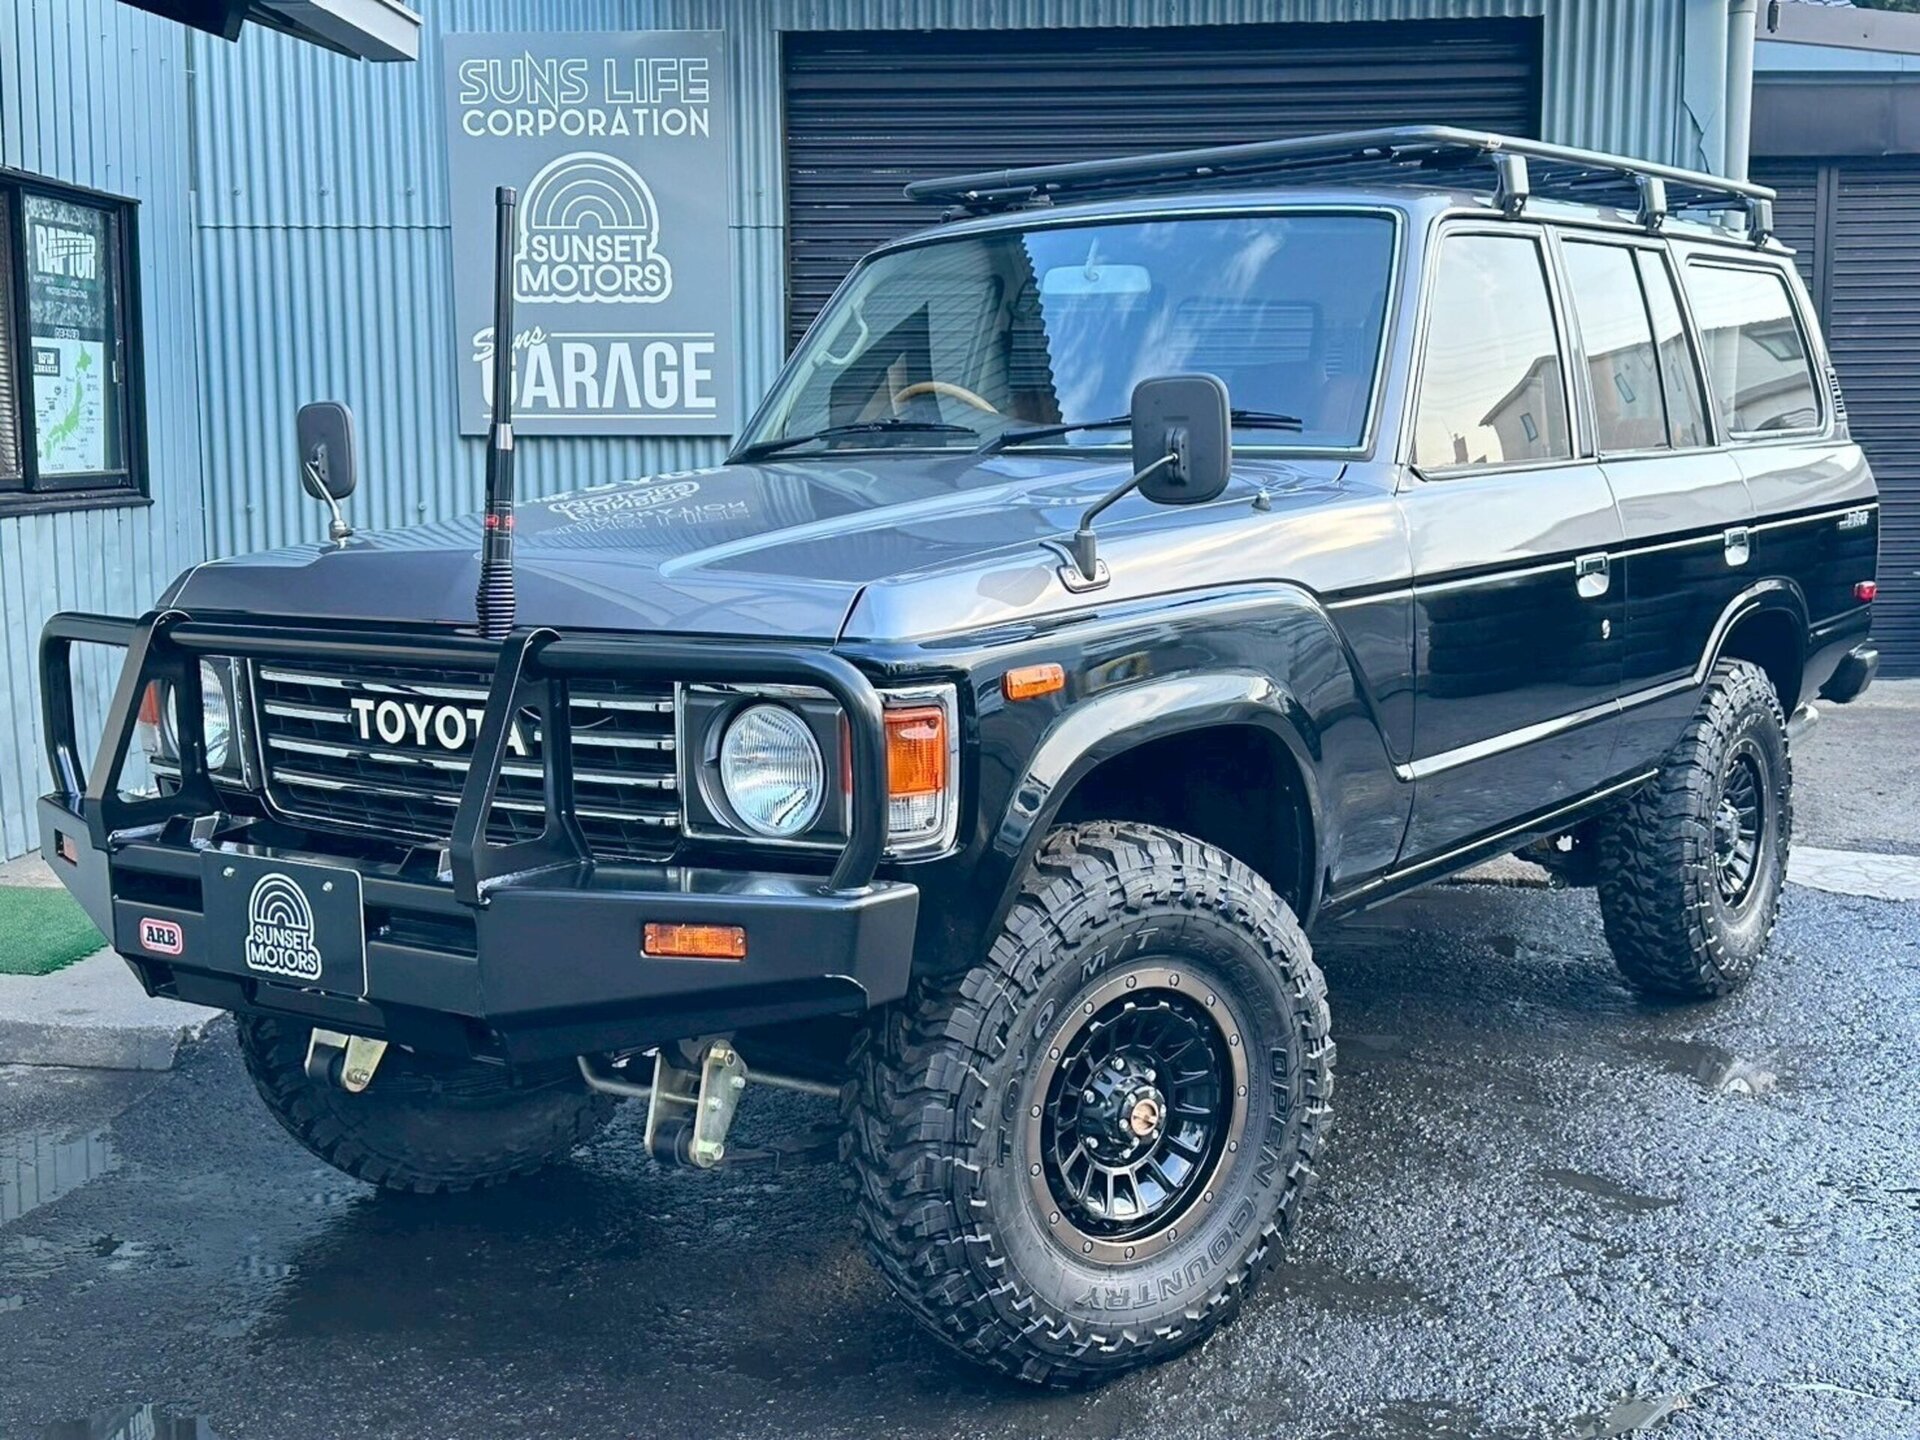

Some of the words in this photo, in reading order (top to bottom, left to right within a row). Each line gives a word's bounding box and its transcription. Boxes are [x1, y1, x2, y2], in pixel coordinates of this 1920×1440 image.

[458, 50, 589, 112] SUNS
[603, 58, 710, 104] LIFE
[462, 106, 710, 138] CORPORATION
[34, 224, 96, 280] RAPTOR
[531, 234, 647, 262] SUNSET
[520, 264, 662, 293] MOTORS
[472, 325, 546, 362] Sns
[146, 926, 177, 947] ARB
[254, 924, 309, 950] SUNSET
[250, 942, 318, 973] MOTORS
[1253, 1046, 1290, 1189] OPEN
[1074, 1196, 1256, 1311] COUNTRY
